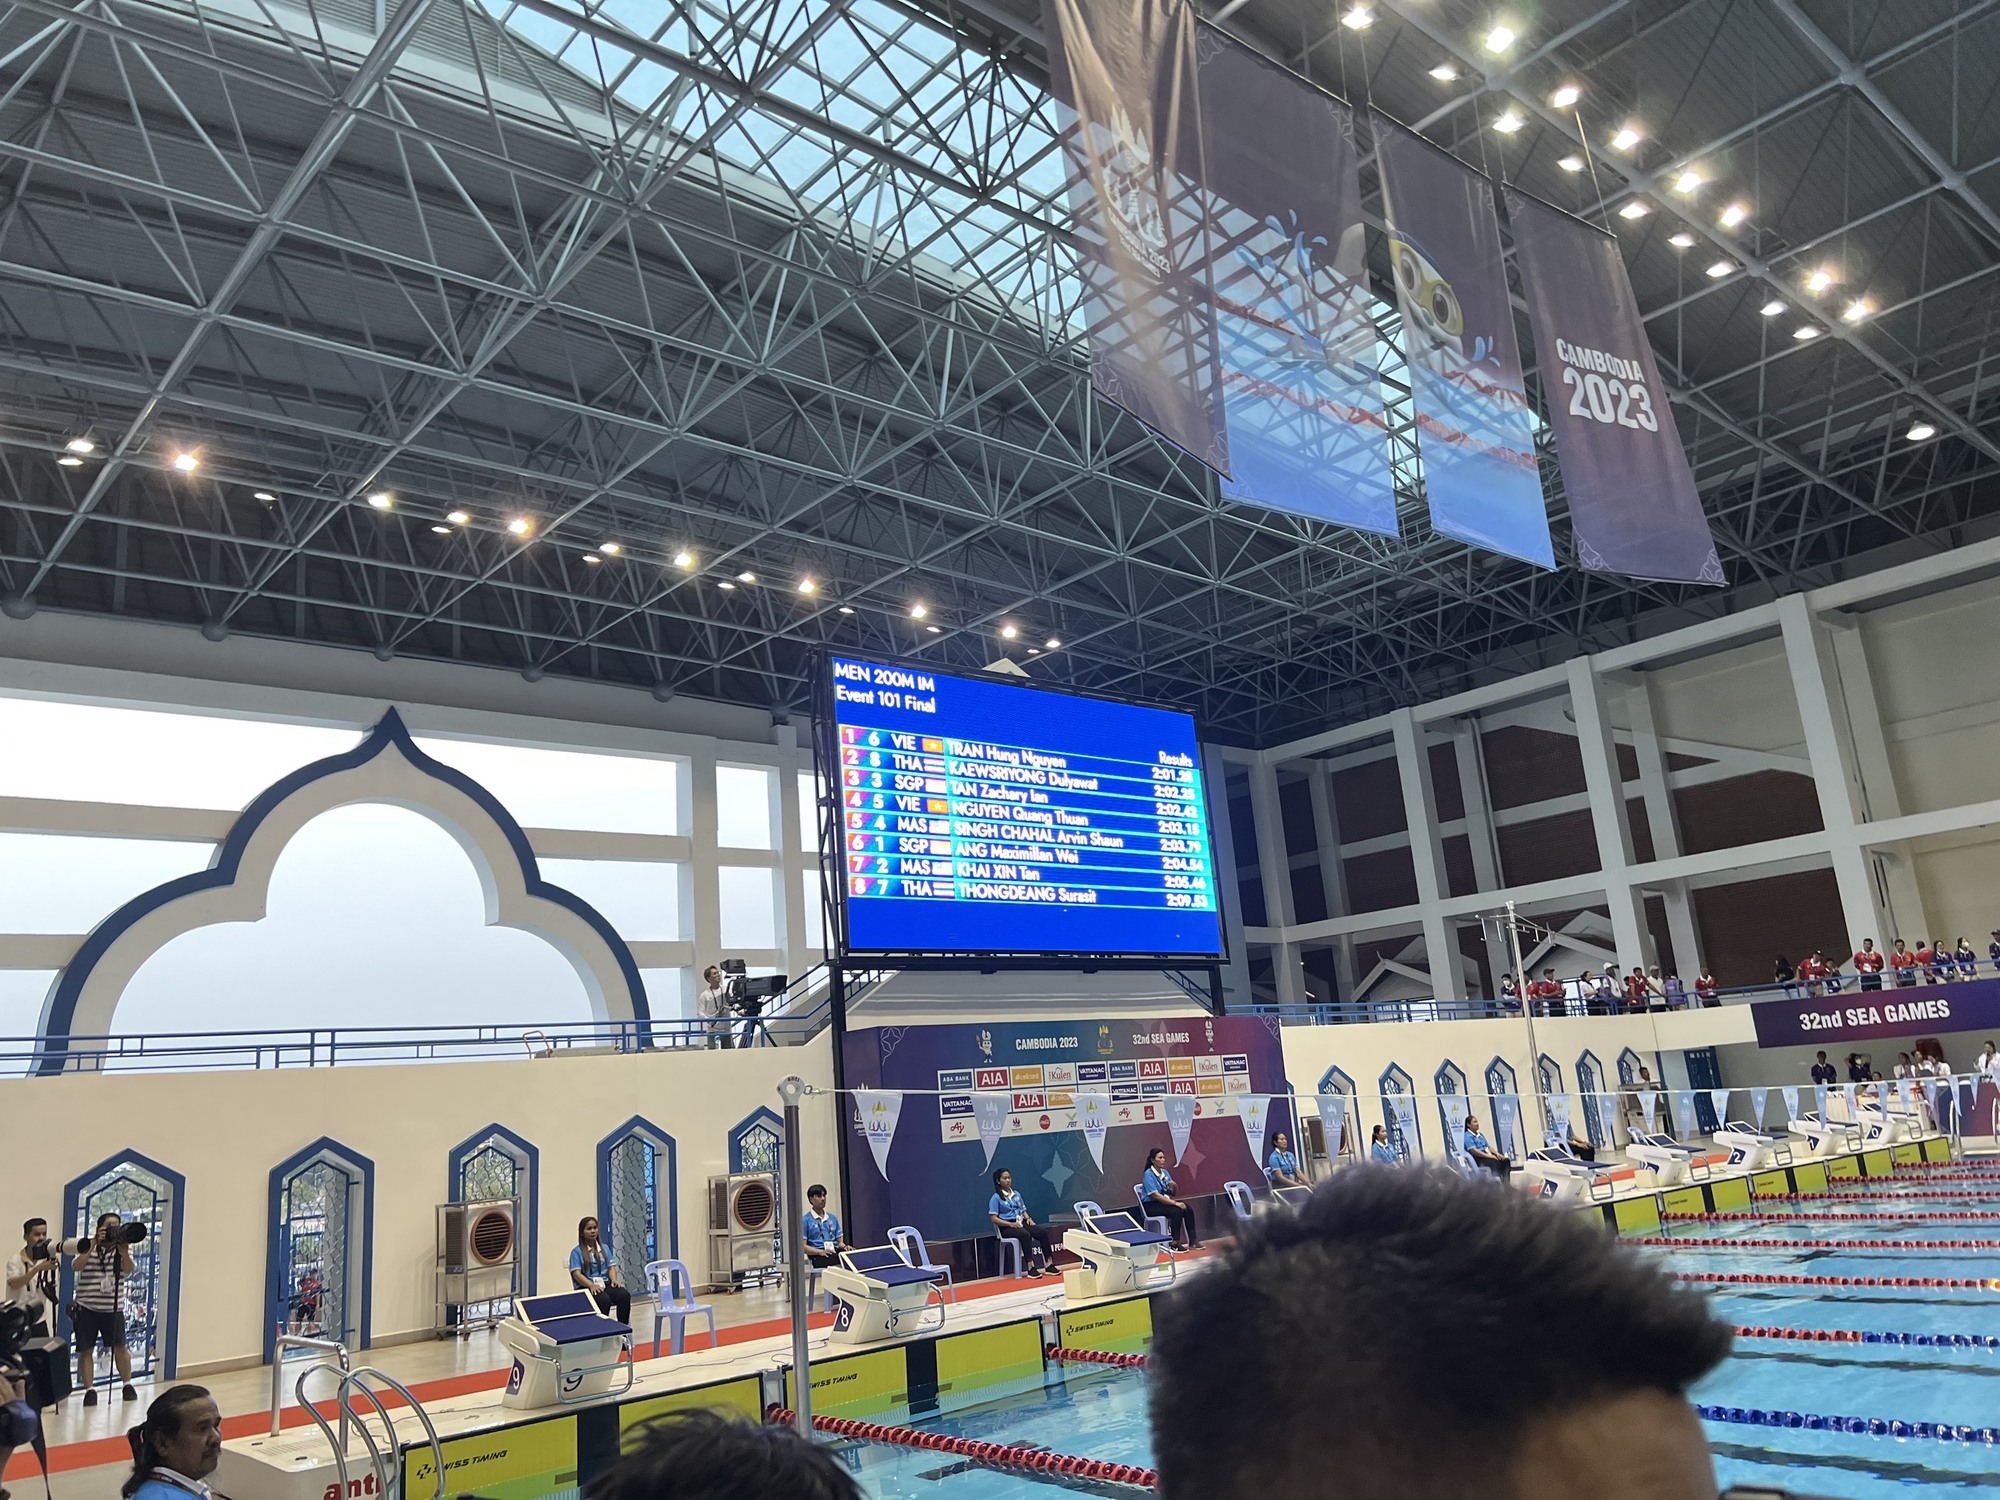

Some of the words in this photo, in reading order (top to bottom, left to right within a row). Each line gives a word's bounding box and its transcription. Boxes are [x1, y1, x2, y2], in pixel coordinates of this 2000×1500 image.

[1148, 247, 1171, 274] 2023
[1556, 338, 1646, 383] CAMBODIA
[1563, 366, 1658, 432] 2023
[834, 662, 871, 683] MEN
[873, 670, 915, 690] 200M
[917, 676, 935, 692] IM
[836, 685, 874, 704] Event
[877, 691, 901, 708] 101
[905, 695, 936, 713] Final
[845, 729, 855, 743] 1
[868, 731, 880, 746] 6
[890, 733, 916, 750] VIE
[947, 740, 984, 758] TRAN
[986, 746, 1019, 765] Hung
[1021, 751, 1067, 769] Nguyen
[1158, 750, 1193, 767] Results
[847, 750, 859, 765] 2
[869, 752, 881, 767] 8
[892, 754, 923, 771] THA
[950, 760, 1046, 784] KAEWSRIYONG
[1048, 772, 1098, 790] Dulyawat
[848, 771, 859, 786] 3
[871, 772, 882, 788] 3
[895, 775, 924, 791] SGP
[951, 780, 978, 797] TAN
[980, 784, 1027, 803] Zachary
[1030, 789, 1048, 803] Ian
[850, 792, 862, 807] 4
[873, 794, 884, 809] 5
[896, 795, 920, 811] VIE
[952, 801, 1010, 820] NGUYEN
[1013, 807, 1053, 825] Quang
[1054, 810, 1089, 826] Thuan
[851, 813, 863, 828] 5
[874, 815, 886, 830] 4
[898, 816, 928, 833] MAS
[954, 822, 998, 838] SINGH
[1001, 825, 1056, 842] CHAHAL
[1057, 830, 1088, 846] Arvin
[1090, 832, 1124, 848] Shaun
[852, 835, 864, 850] 6
[875, 836, 884, 851] 1
[899, 837, 928, 854] SGP
[955, 841, 988, 858] ANG
[1055, 848, 1079, 864] Wei
[852, 857, 864, 872] 7
[877, 858, 889, 873] 2
[901, 859, 930, 875] MAS
[956, 862, 990, 878] KHAI
[993, 865, 1017, 879] XIN
[1019, 866, 1040, 881] Tan
[854, 878, 866, 894] 8
[877, 879, 889, 895] 7
[901, 880, 932, 896] THA
[958, 883, 1057, 901] THONGDEANG
[1058, 888, 1097, 903] Surasit
[1800, 1010, 1842, 1031] 32nd
[1846, 1007, 1881, 1027] SEA
[1884, 999, 1951, 1023] GAMES
[1015, 1038, 1058, 1050] CAMBODIA
[1059, 1037, 1078, 1048] 2023
[1132, 1034, 1150, 1045] 32nd
[1151, 1033, 1165, 1044] SEA
[1165, 1032, 1190, 1043] GAMES
[981, 1072, 1004, 1086] AIA
[1051, 1071, 1071, 1080] Kulen
[1143, 1062, 1163, 1075] AIA
[1174, 1082, 1193, 1094] AIA
[1018, 1094, 1041, 1107] AIA
[1733, 1151, 1742, 1163] 2
[1544, 1184, 1552, 1197] 4
[661, 1271, 667, 1282] 8
[840, 1307, 850, 1327] 8
[1074, 1322, 1094, 1333] SWISS
[512, 1366, 520, 1390] 9
